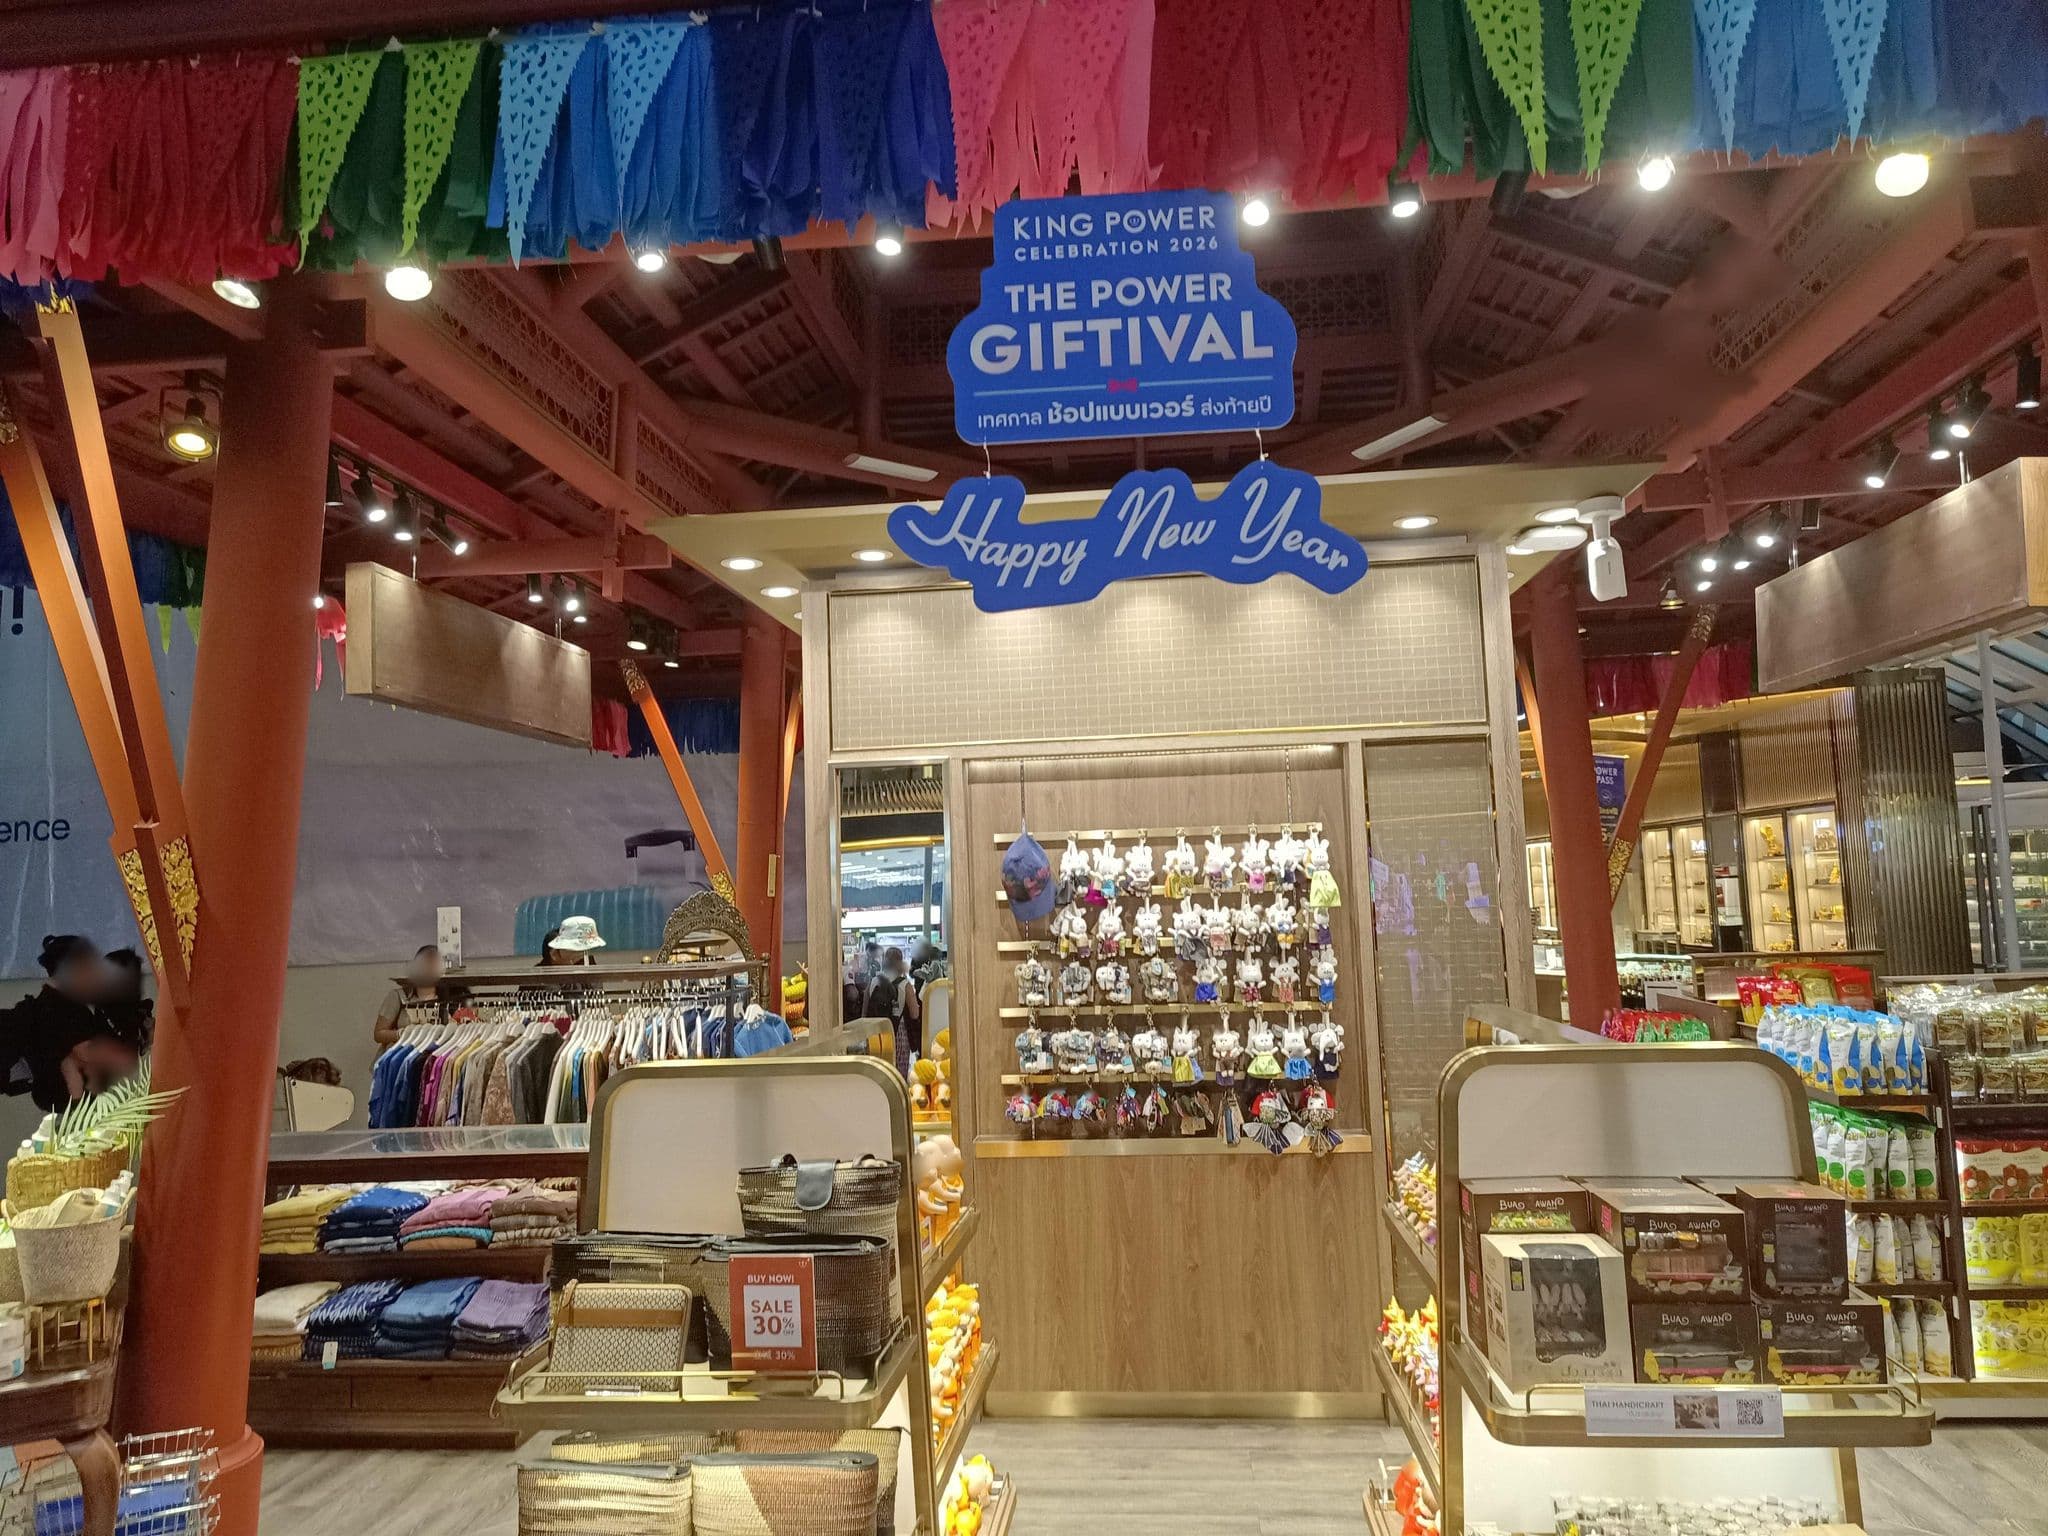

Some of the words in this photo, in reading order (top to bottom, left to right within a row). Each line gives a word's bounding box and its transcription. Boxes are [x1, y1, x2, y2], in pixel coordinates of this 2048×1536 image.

[1013, 213, 1093, 241] KING
[1106, 206, 1215, 235] POWER
[1014, 239, 1159, 262] CELEBRATION
[1170, 236, 1219, 253] 2026
[1004, 282, 1076, 313] THE
[1091, 272, 1232, 308] POWER
[969, 310, 1274, 375] GIFTIVAL
[978, 409, 1042, 429] เทศกาล
[1048, 395, 1195, 425] ช้อปแบบเวอร์
[1201, 394, 1272, 416] ส่งท้ายปี
[906, 493, 1089, 588] Happy
[1113, 485, 1217, 560] New
[1231, 478, 1349, 572] Year
[1593, 766, 1618, 777] OWER
[0, 819, 70, 842] ence
[747, 1274, 766, 1284] BUY
[769, 1274, 794, 1284] NOW!
[751, 1300, 793, 1313] SALE
[753, 1315, 794, 1335] 30%
[1592, 1400, 1611, 1409] THAI
[1613, 1400, 1665, 1410] HANDICRAFT
